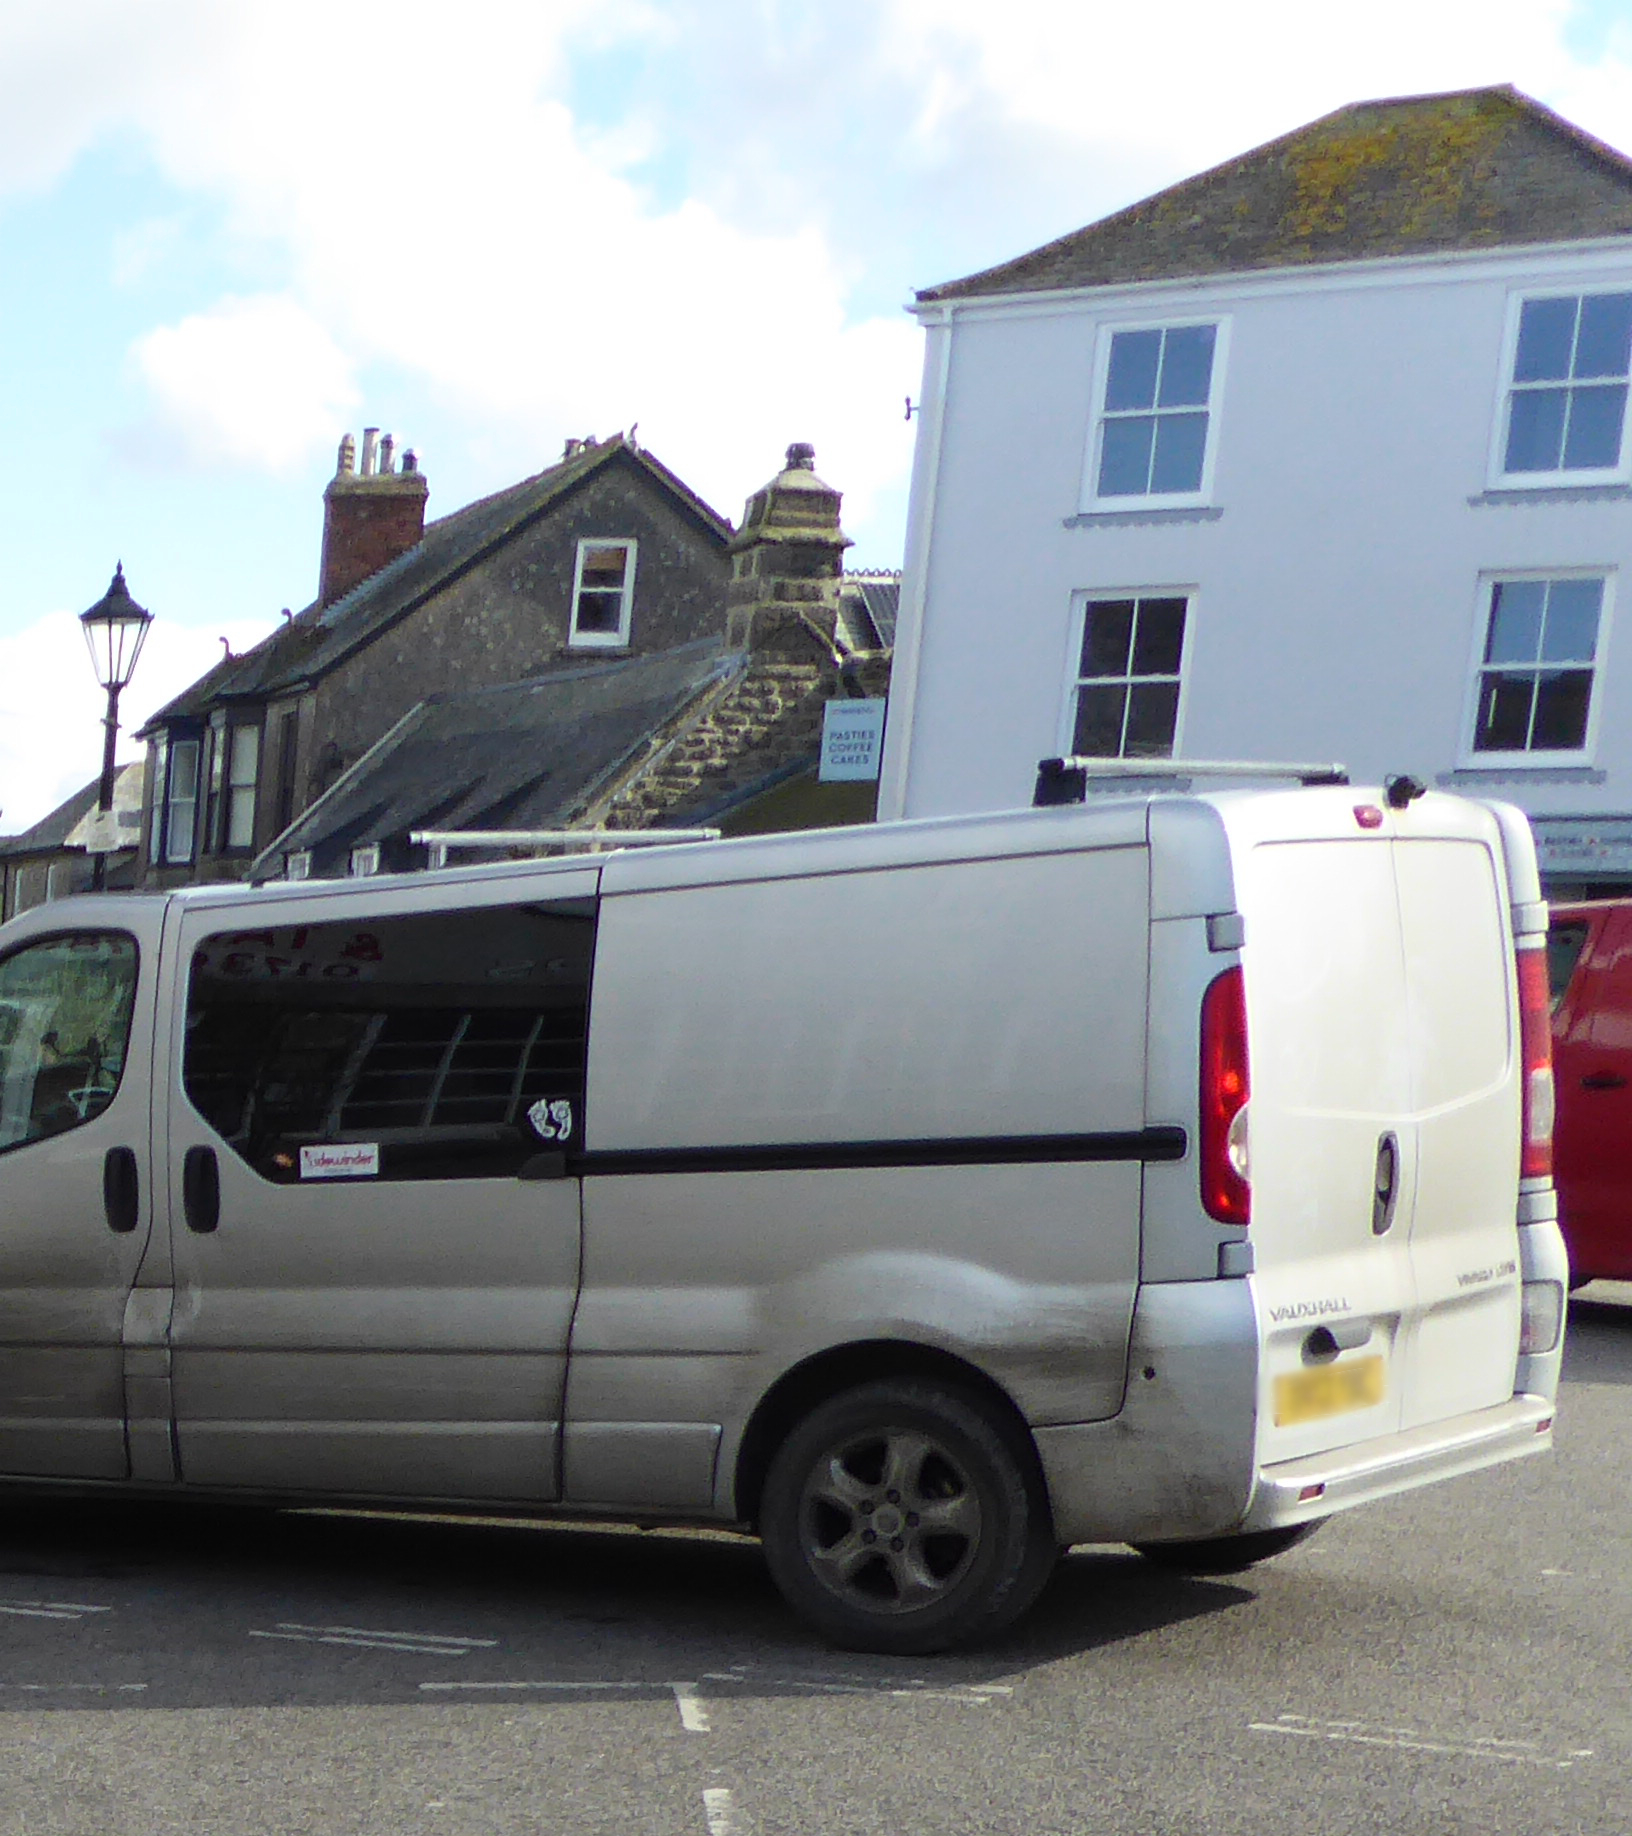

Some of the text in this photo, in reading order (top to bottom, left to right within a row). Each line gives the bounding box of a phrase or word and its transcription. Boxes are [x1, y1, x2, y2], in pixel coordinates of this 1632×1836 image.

[829, 729, 876, 741] PASTIES
[828, 742, 873, 753] COFFEE
[830, 754, 870, 765] CAKES
[1269, 1297, 1352, 1322] VAUXHALL
